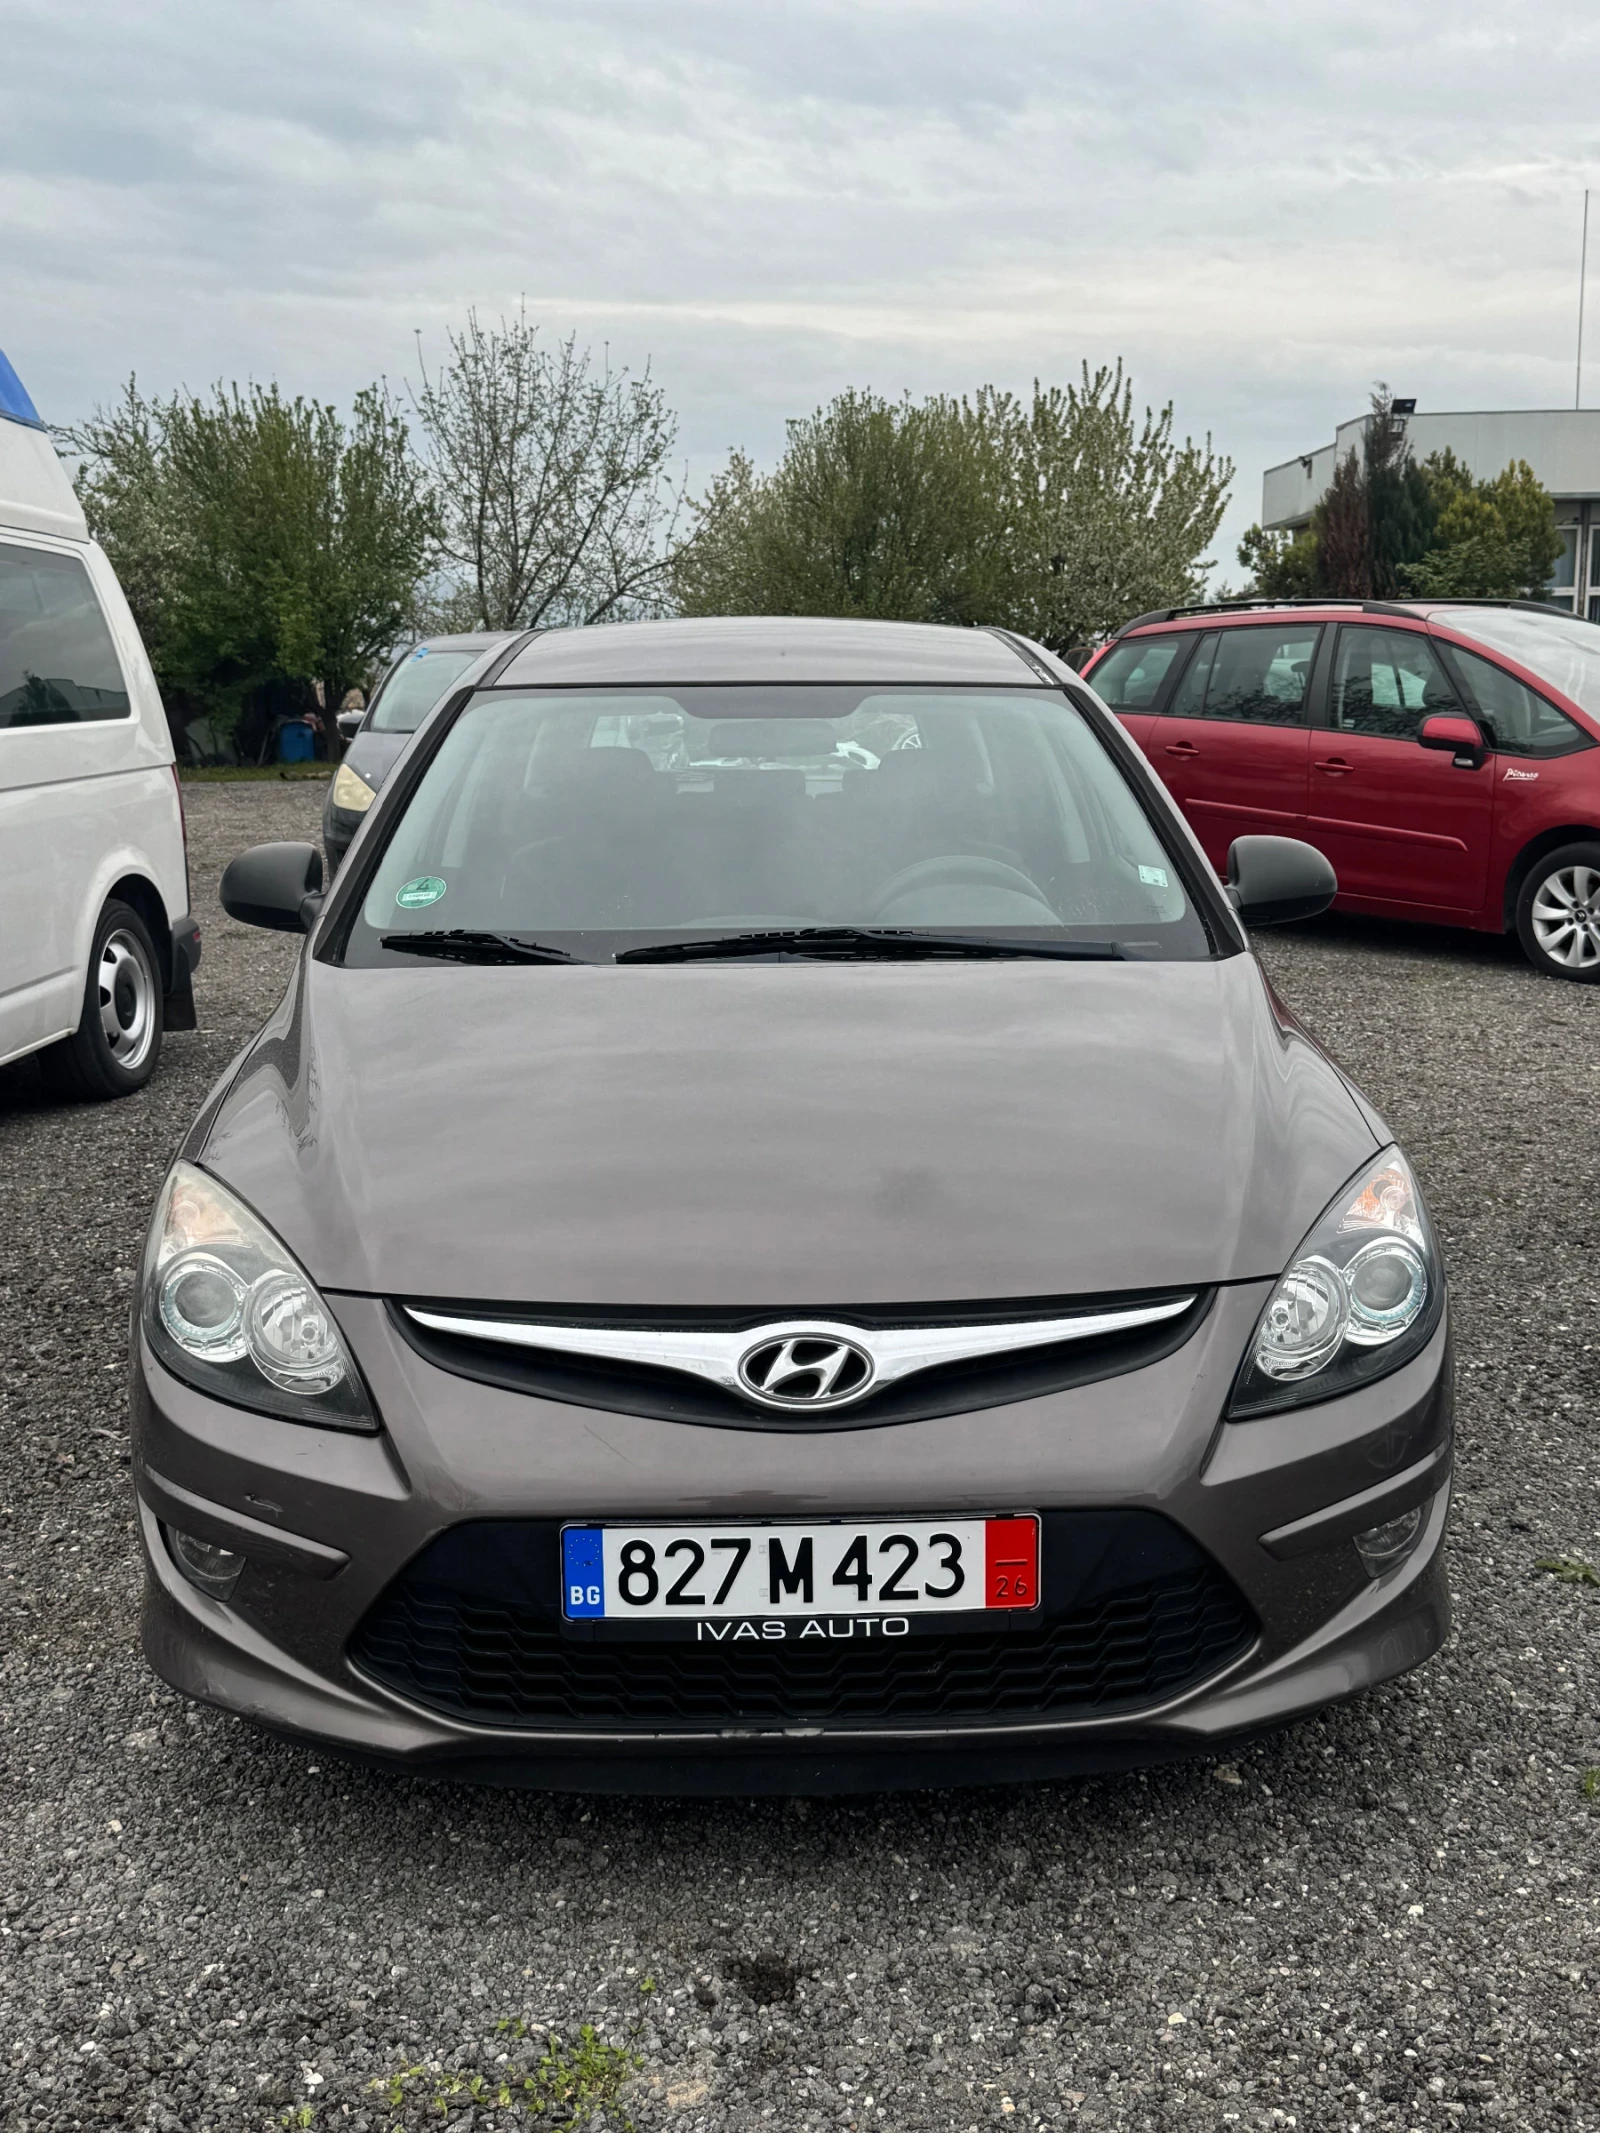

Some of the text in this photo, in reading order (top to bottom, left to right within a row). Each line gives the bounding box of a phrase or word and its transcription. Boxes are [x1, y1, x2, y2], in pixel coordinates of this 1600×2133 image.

[618, 1533, 965, 1606] 827 M 423
[570, 1585, 600, 1605] BG
[996, 1574, 1028, 1598] 26
[697, 1617, 909, 1641] IVAS AUTO
